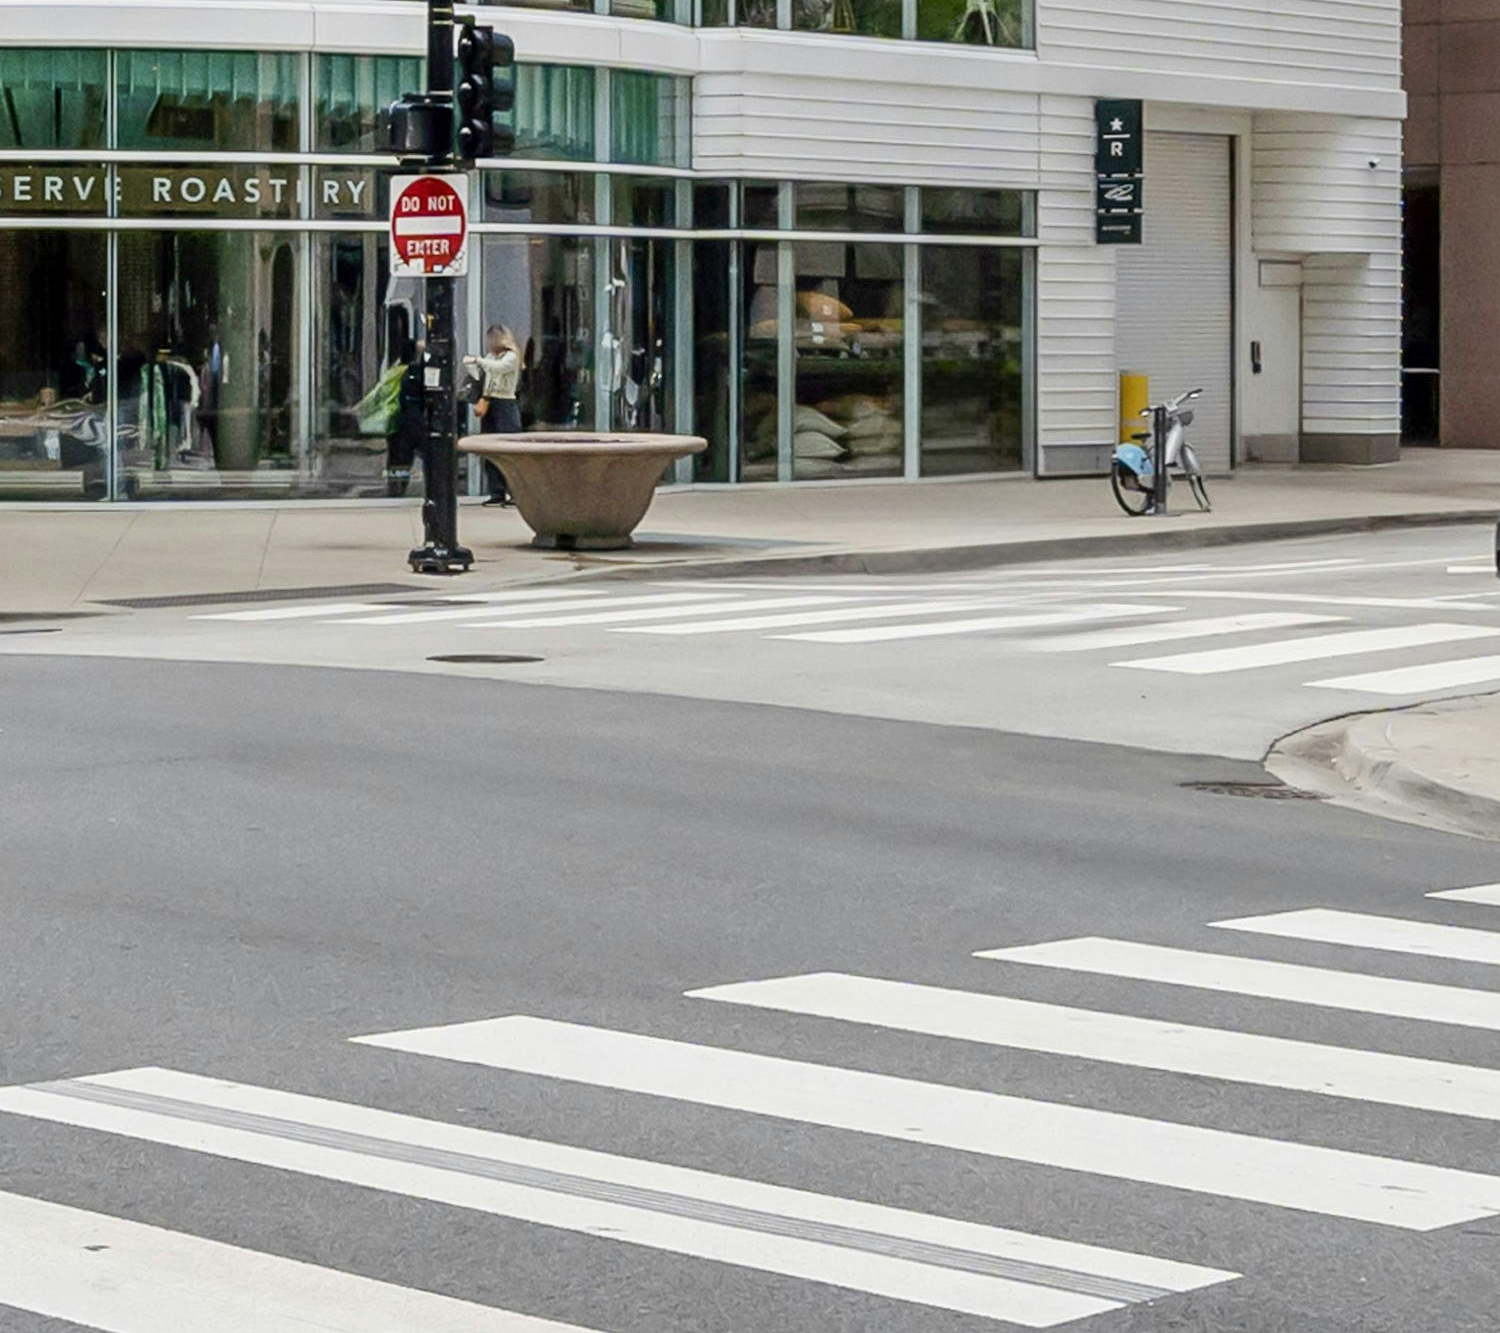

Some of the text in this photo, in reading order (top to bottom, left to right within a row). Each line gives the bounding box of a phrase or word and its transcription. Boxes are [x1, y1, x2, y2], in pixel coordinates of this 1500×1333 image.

[1110, 140, 1124, 157] R
[152, 177, 367, 204] ROASTRY
[402, 194, 456, 213] DO NOT
[406, 238, 451, 256] ENTER
